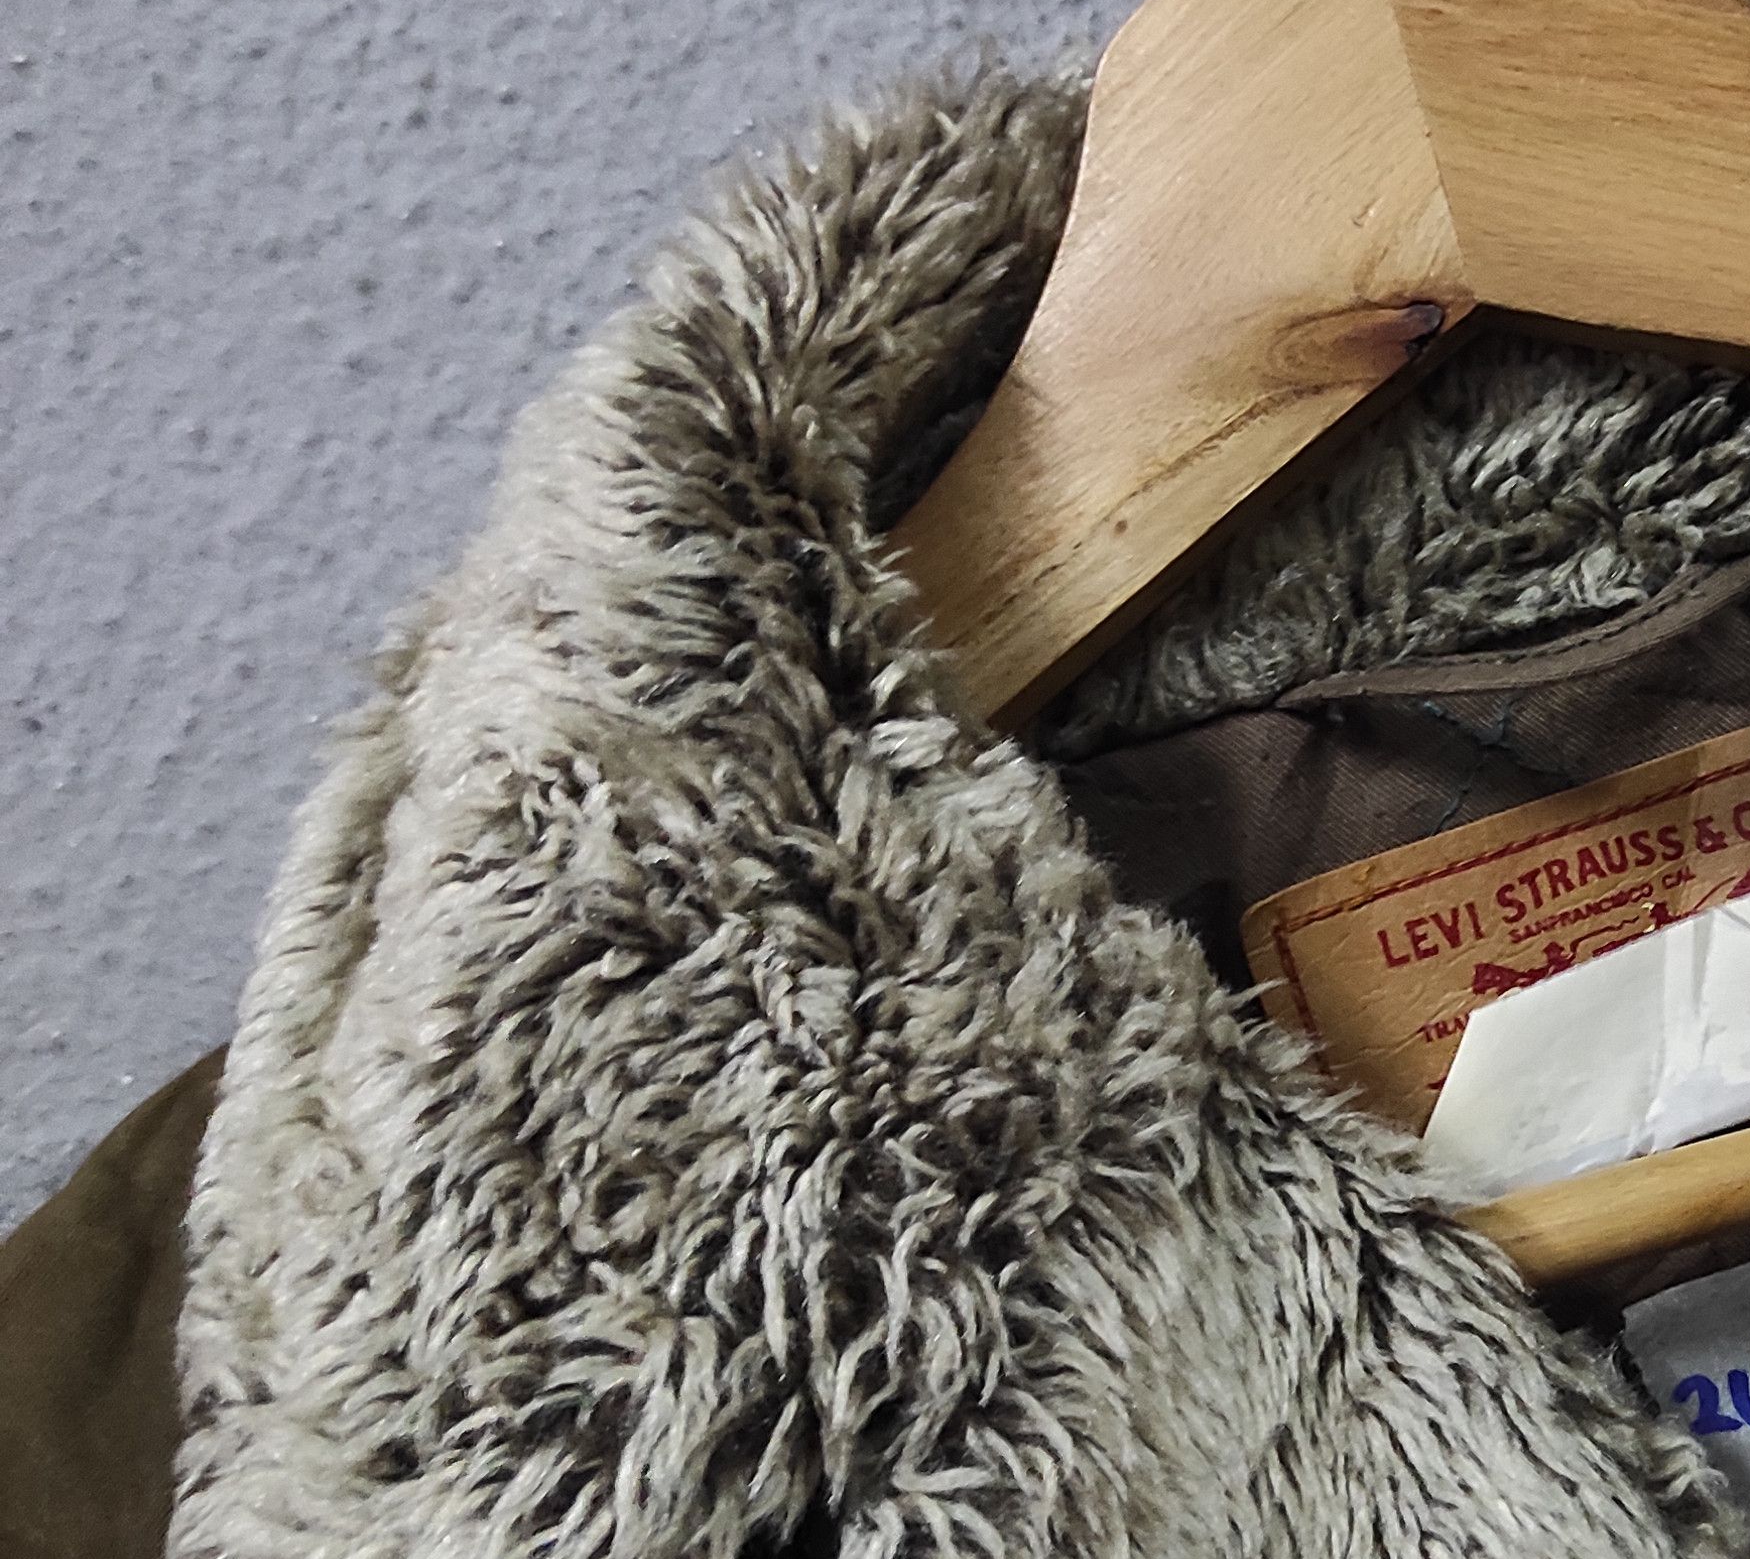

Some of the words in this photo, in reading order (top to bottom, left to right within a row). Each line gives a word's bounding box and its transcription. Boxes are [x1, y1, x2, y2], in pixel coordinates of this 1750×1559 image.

[1377, 902, 1484, 969] LEVI
[1495, 825, 1684, 925] STRAUSS
[1694, 816, 1728, 854] &
